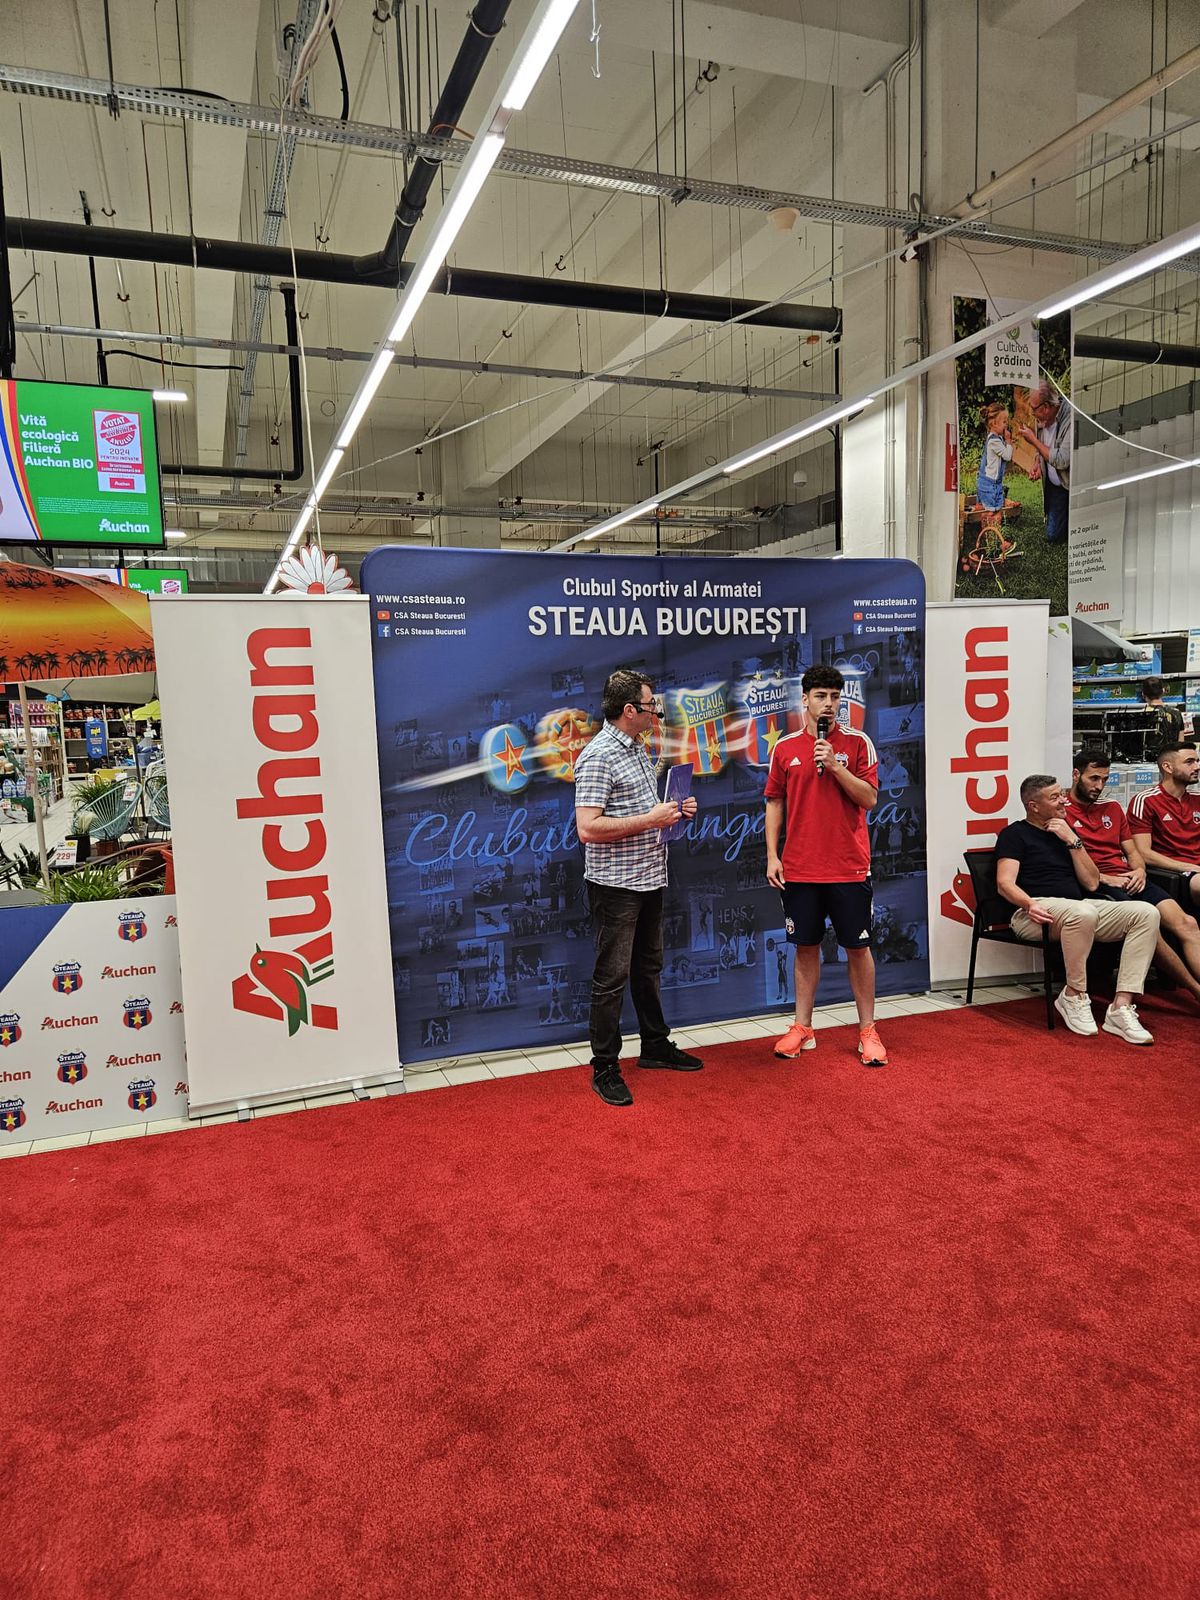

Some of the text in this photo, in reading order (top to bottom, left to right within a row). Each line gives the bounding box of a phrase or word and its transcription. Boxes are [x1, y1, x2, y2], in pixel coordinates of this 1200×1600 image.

[996, 341, 1029, 354] Cultivă
[993, 355, 1032, 367] grădina
[20, 414, 47, 426] Vită
[103, 416, 126, 428] VOTAT
[21, 430, 79, 443] ecologică
[23, 442, 62, 454] Filieră
[24, 456, 94, 469] Auchan BIO
[99, 519, 150, 533] Auchan
[1082, 524, 1099, 533] aprilie
[562, 578, 762, 600] Clubul Sportiv al Armatei
[376, 594, 466, 605] www.csasteaua.ro
[853, 598, 918, 606] www.csasteaua.ro
[1075, 601, 1110, 613] Auchan
[528, 605, 807, 643] STEAUA BUCUREȘTI
[748, 684, 789, 704] STEAUA
[684, 691, 725, 714] STEAUA
[232, 627, 339, 1038] Auchan
[405, 808, 578, 866] Clubul
[120, 912, 144, 920] STEAUA
[54, 963, 80, 972] STEAUA
[101, 965, 156, 979] Auchan
[124, 998, 149, 1008] STEAUA
[40, 1015, 99, 1030] Auchan
[59, 1052, 84, 1062] STEAUA
[106, 1053, 161, 1068] Auchan
[129, 1080, 153, 1089] STEAUA
[45, 1098, 103, 1115] Auchan
